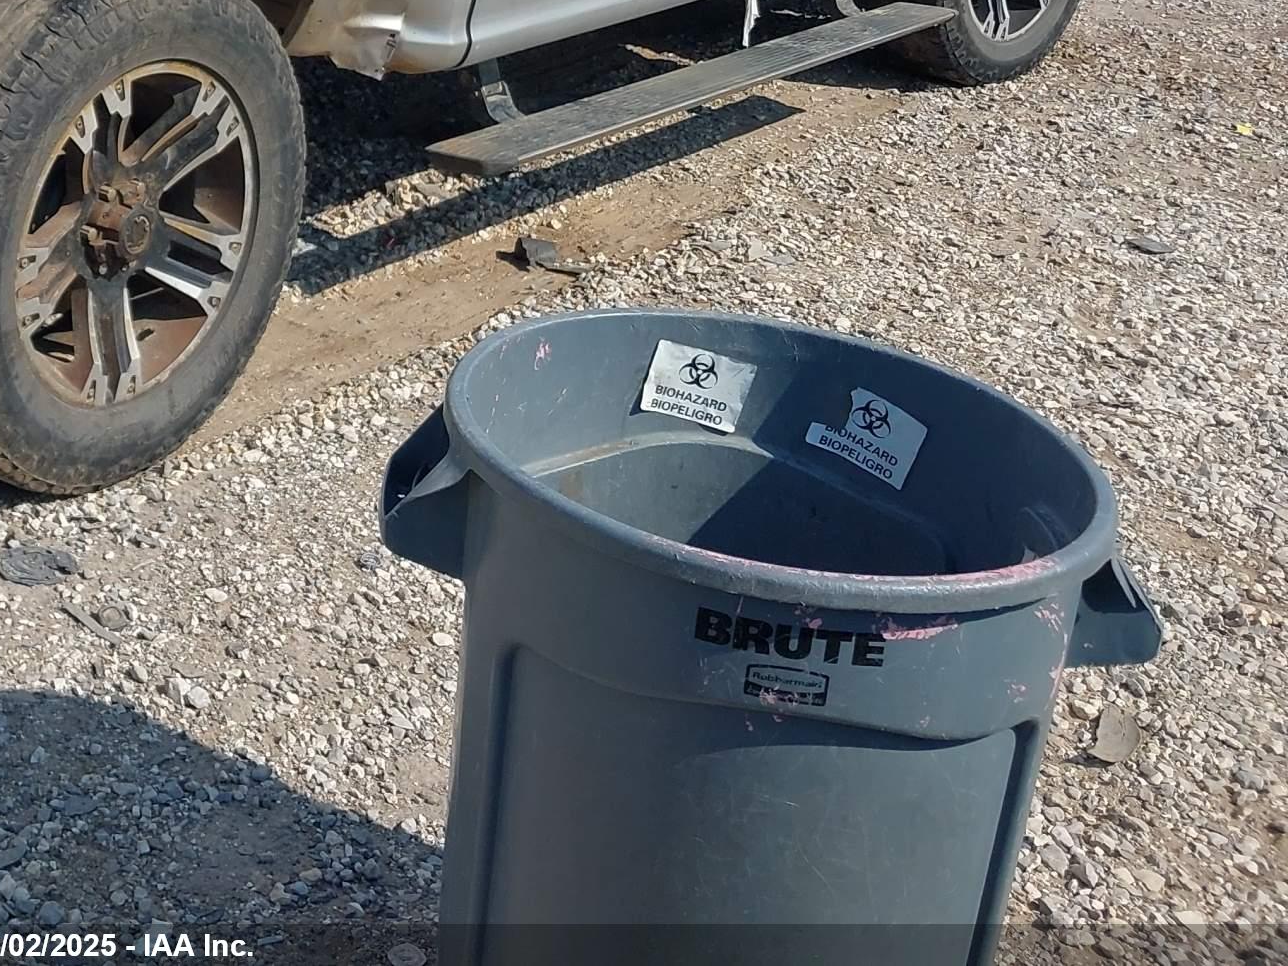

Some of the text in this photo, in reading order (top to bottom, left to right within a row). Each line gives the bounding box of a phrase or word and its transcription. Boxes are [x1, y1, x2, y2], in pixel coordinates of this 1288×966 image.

[650, 398, 723, 426] BIOPELIGRO
[654, 384, 727, 412] BIOHAZARD
[818, 435, 893, 480] BIOPELIGRO
[694, 606, 887, 667] BRUTE
